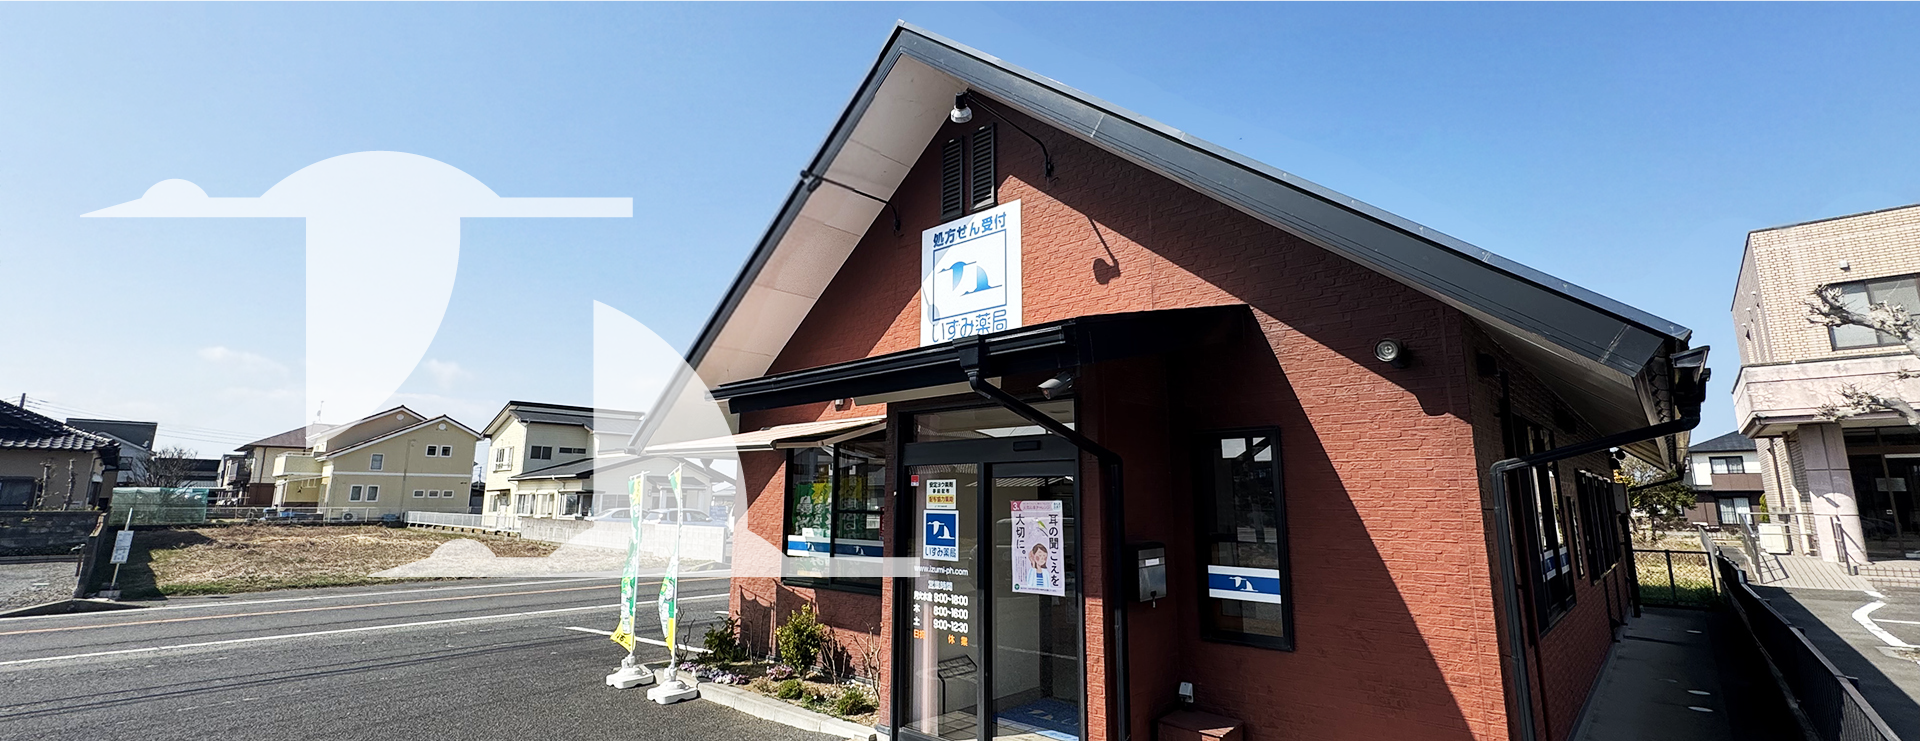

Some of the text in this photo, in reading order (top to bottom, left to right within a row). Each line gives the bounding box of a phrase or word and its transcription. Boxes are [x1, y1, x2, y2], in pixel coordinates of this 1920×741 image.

[933, 212, 1007, 248] 処方せん受付
[932, 309, 1008, 343] いずみ薬局
[1015, 513, 1027, 555] 大切に。
[925, 546, 957, 558] いずみ薬局
[1048, 513, 1060, 587] 耳の聞こえを
[914, 566, 969, 577] www.izumi-ph.com
[913, 603, 921, 613] 木
[913, 616, 921, 626] 土
